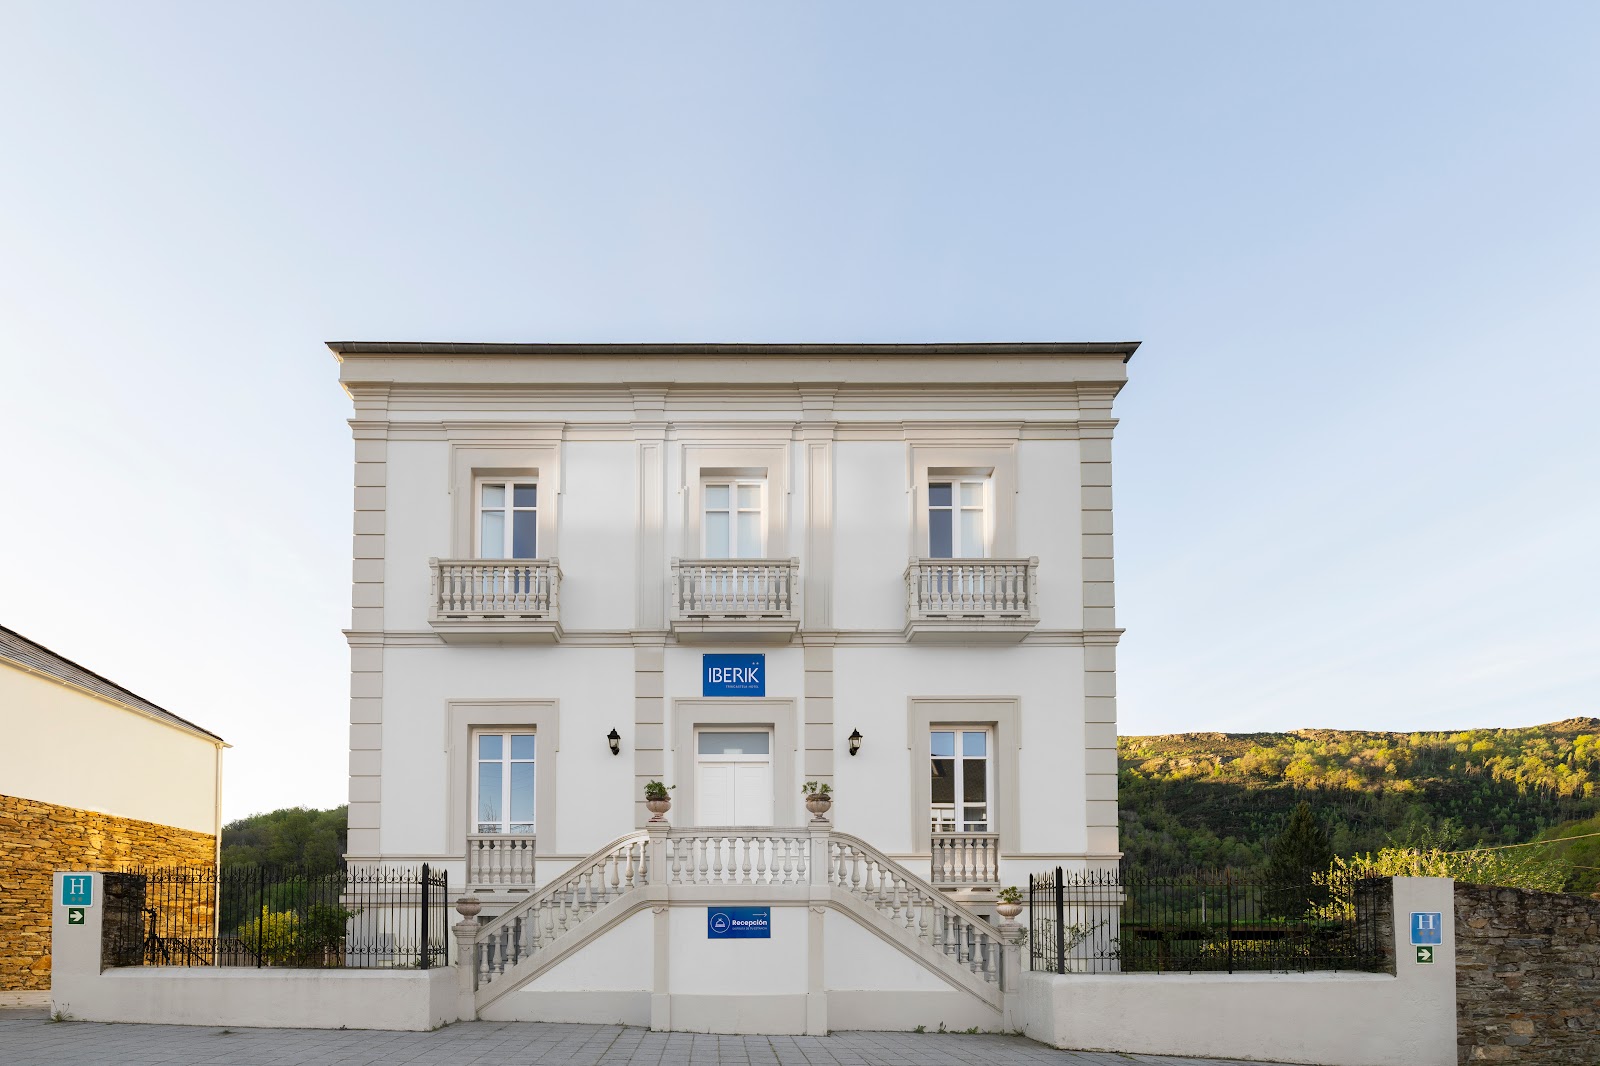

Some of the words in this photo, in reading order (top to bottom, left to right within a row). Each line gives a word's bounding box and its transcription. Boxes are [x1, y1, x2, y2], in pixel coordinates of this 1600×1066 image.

[708, 667, 759, 683] IBERIK
[70, 878, 85, 895] H
[732, 919, 767, 927] Recepción
[1417, 914, 1435, 930] H
